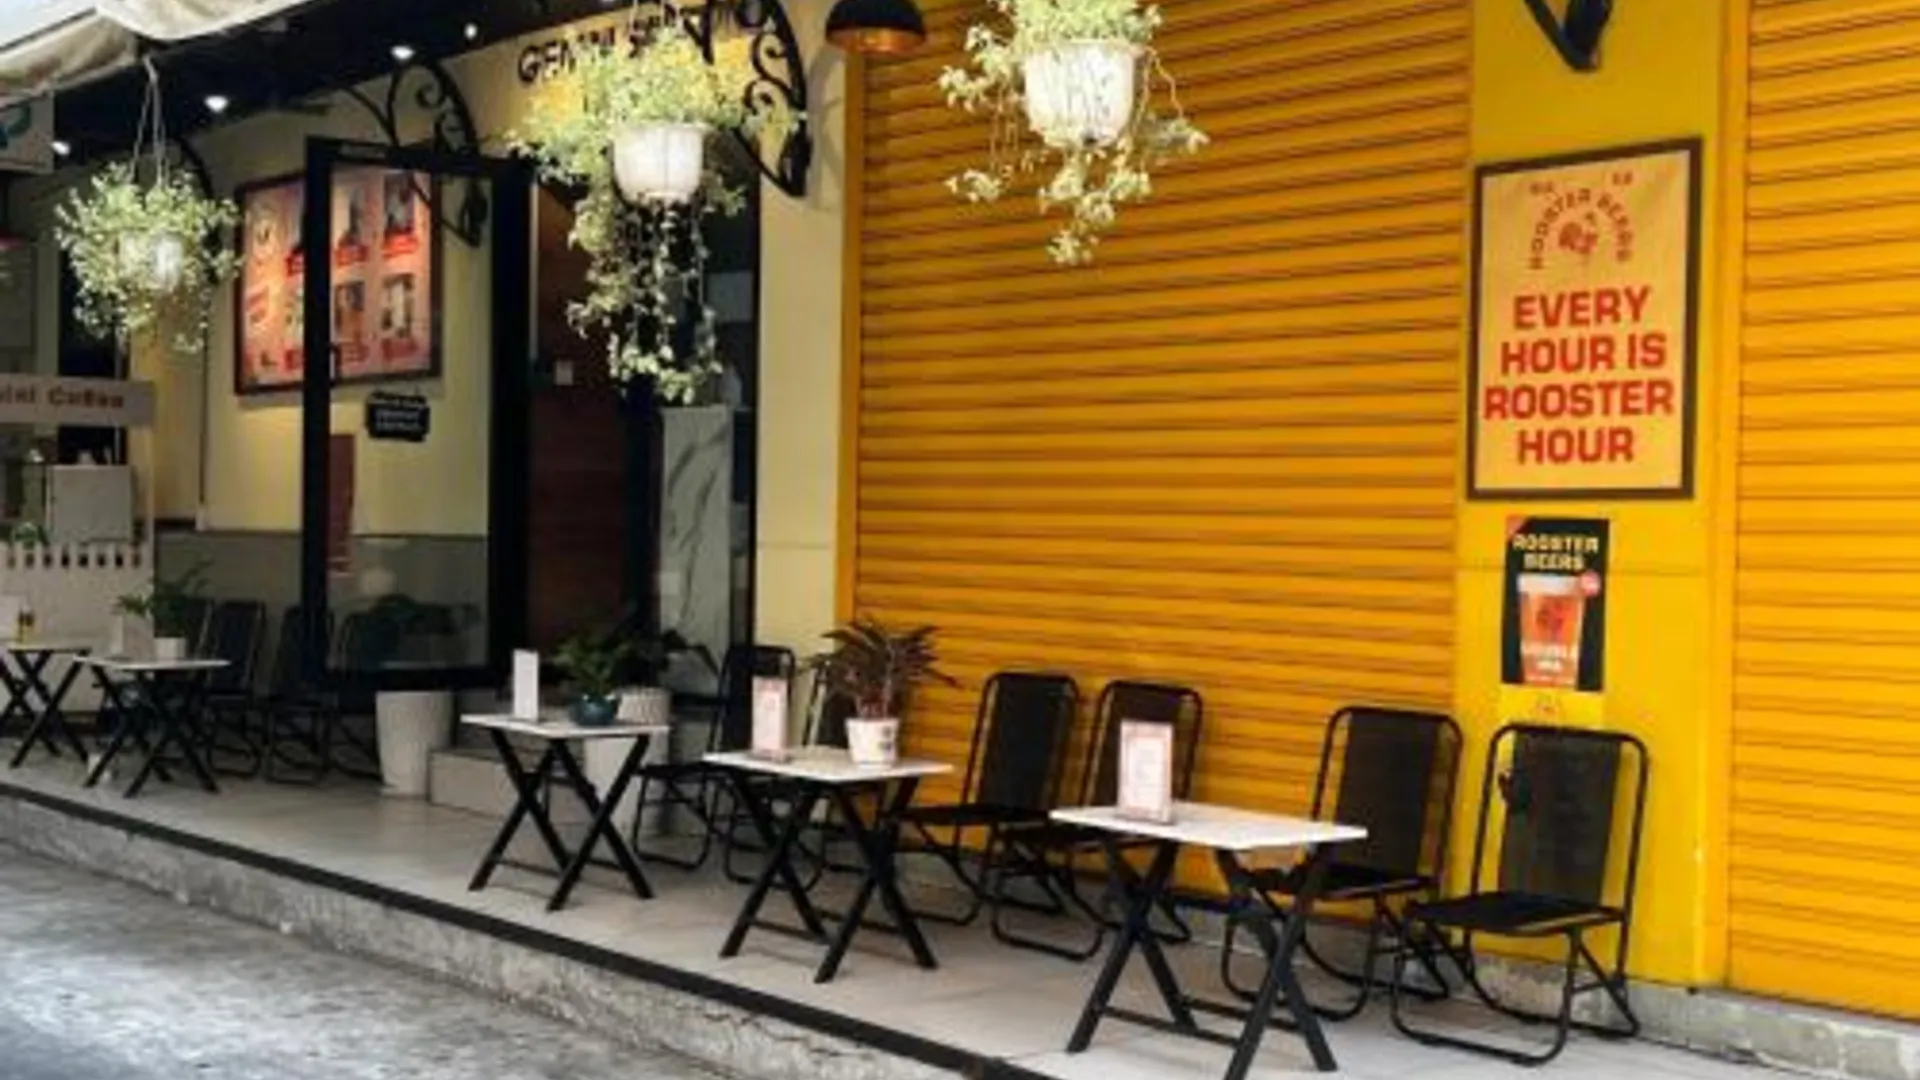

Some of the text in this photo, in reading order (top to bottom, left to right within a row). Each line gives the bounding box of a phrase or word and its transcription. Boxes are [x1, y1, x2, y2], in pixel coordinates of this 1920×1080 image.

[1513, 284, 1651, 330] EVERY
[1501, 332, 1668, 375] HOUR IS
[1484, 379, 1675, 420] ROOSTER
[1518, 426, 1634, 464] HOUR
[1512, 533, 1600, 554] ROOSTER
[1523, 552, 1585, 572] BEERS
